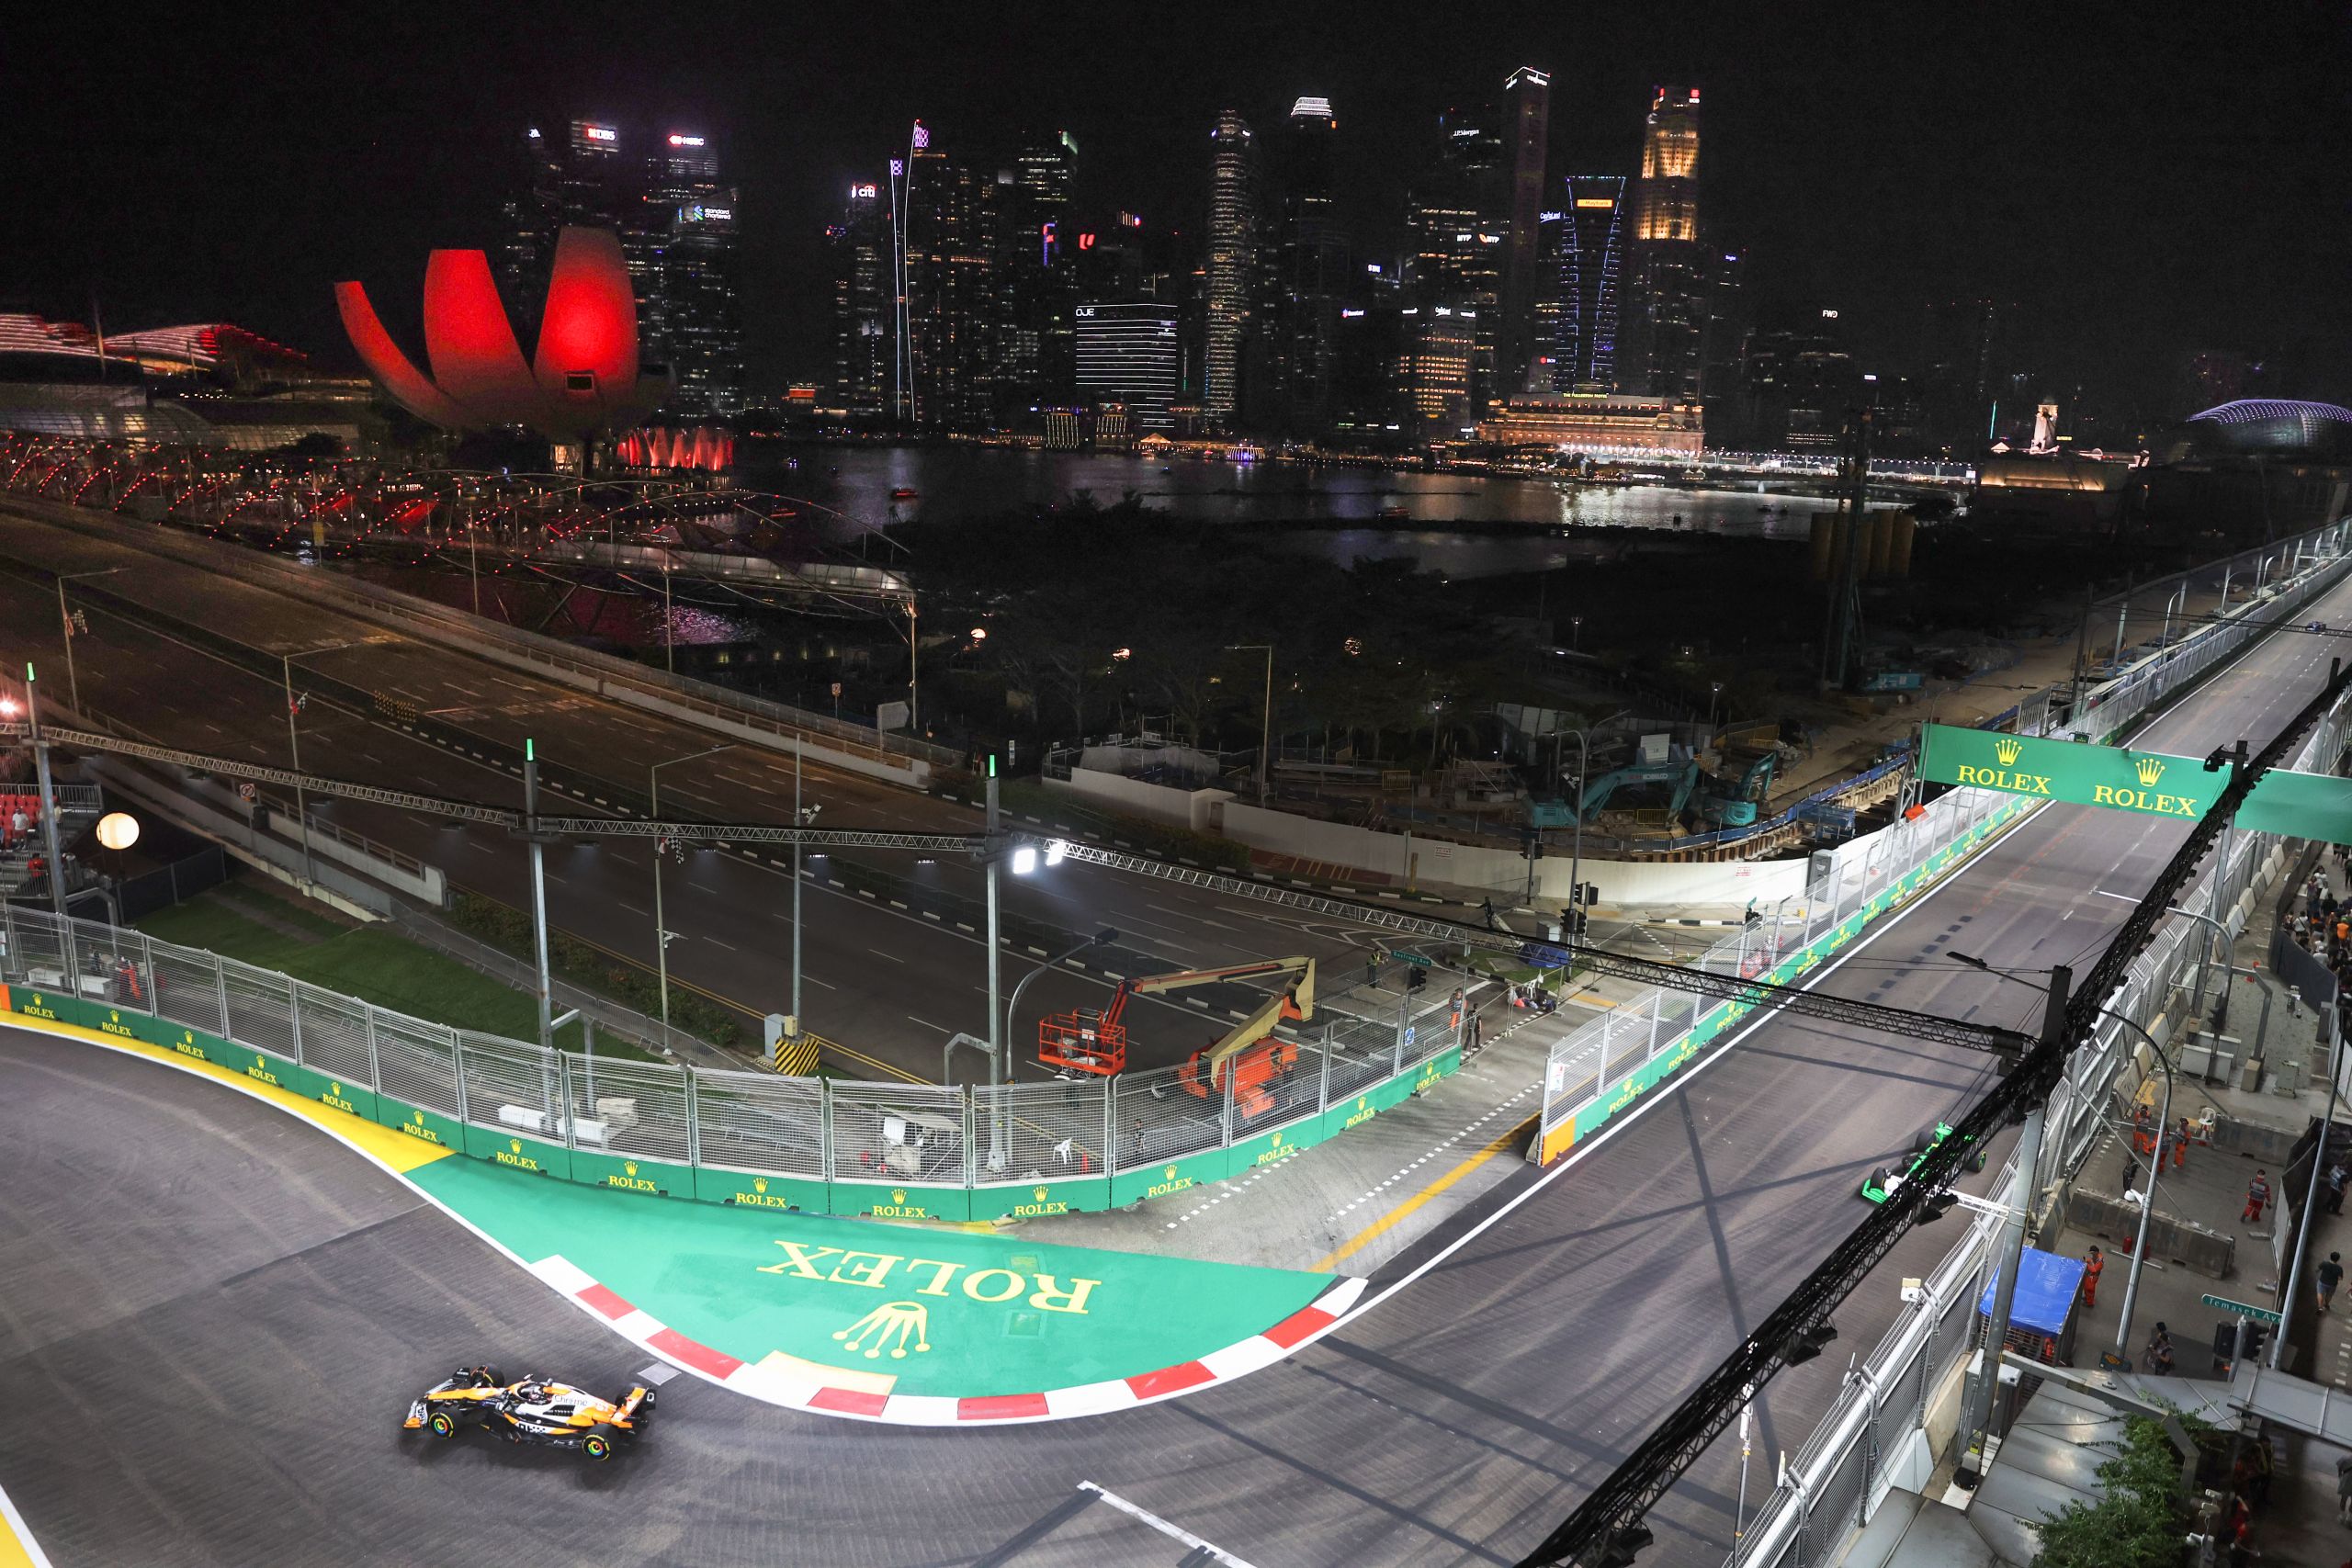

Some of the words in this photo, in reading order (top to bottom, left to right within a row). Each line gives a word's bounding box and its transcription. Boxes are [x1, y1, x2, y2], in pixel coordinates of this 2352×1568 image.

[596, 129, 616, 141] DBS
[858, 186, 876, 198] citi
[705, 207, 730, 216] standard
[705, 211, 731, 220] chartered
[1822, 310, 1838, 319] FWD
[1957, 764, 2052, 795] ROLEX
[2093, 784, 2199, 818] ROLEX
[24, 1004, 55, 1020] ROLEX
[101, 1021, 132, 1037] ROLEX
[176, 1041, 205, 1058] ROLEX
[1668, 1042, 1699, 1070] ROLEX
[248, 1066, 277, 1085] ROLEX
[322, 1093, 354, 1113] ROLEX
[1609, 1082, 1645, 1113] ROLEX
[1346, 1106, 1375, 1130] ROLEX
[403, 1122, 439, 1143] ROLEX
[496, 1151, 538, 1170] ROLEX
[1257, 1143, 1295, 1166] ROLEX
[608, 1175, 657, 1192] ROLEX
[1148, 1177, 1193, 1199] ROLEX
[736, 1192, 787, 1209] ROLEX
[1014, 1201, 1069, 1216] ROLEX
[873, 1205, 926, 1218] ROLEX
[756, 1240, 1102, 1314] ROLEX
[2209, 1298, 2257, 1317] Temasek
[554, 1393, 588, 1406] Chrome
